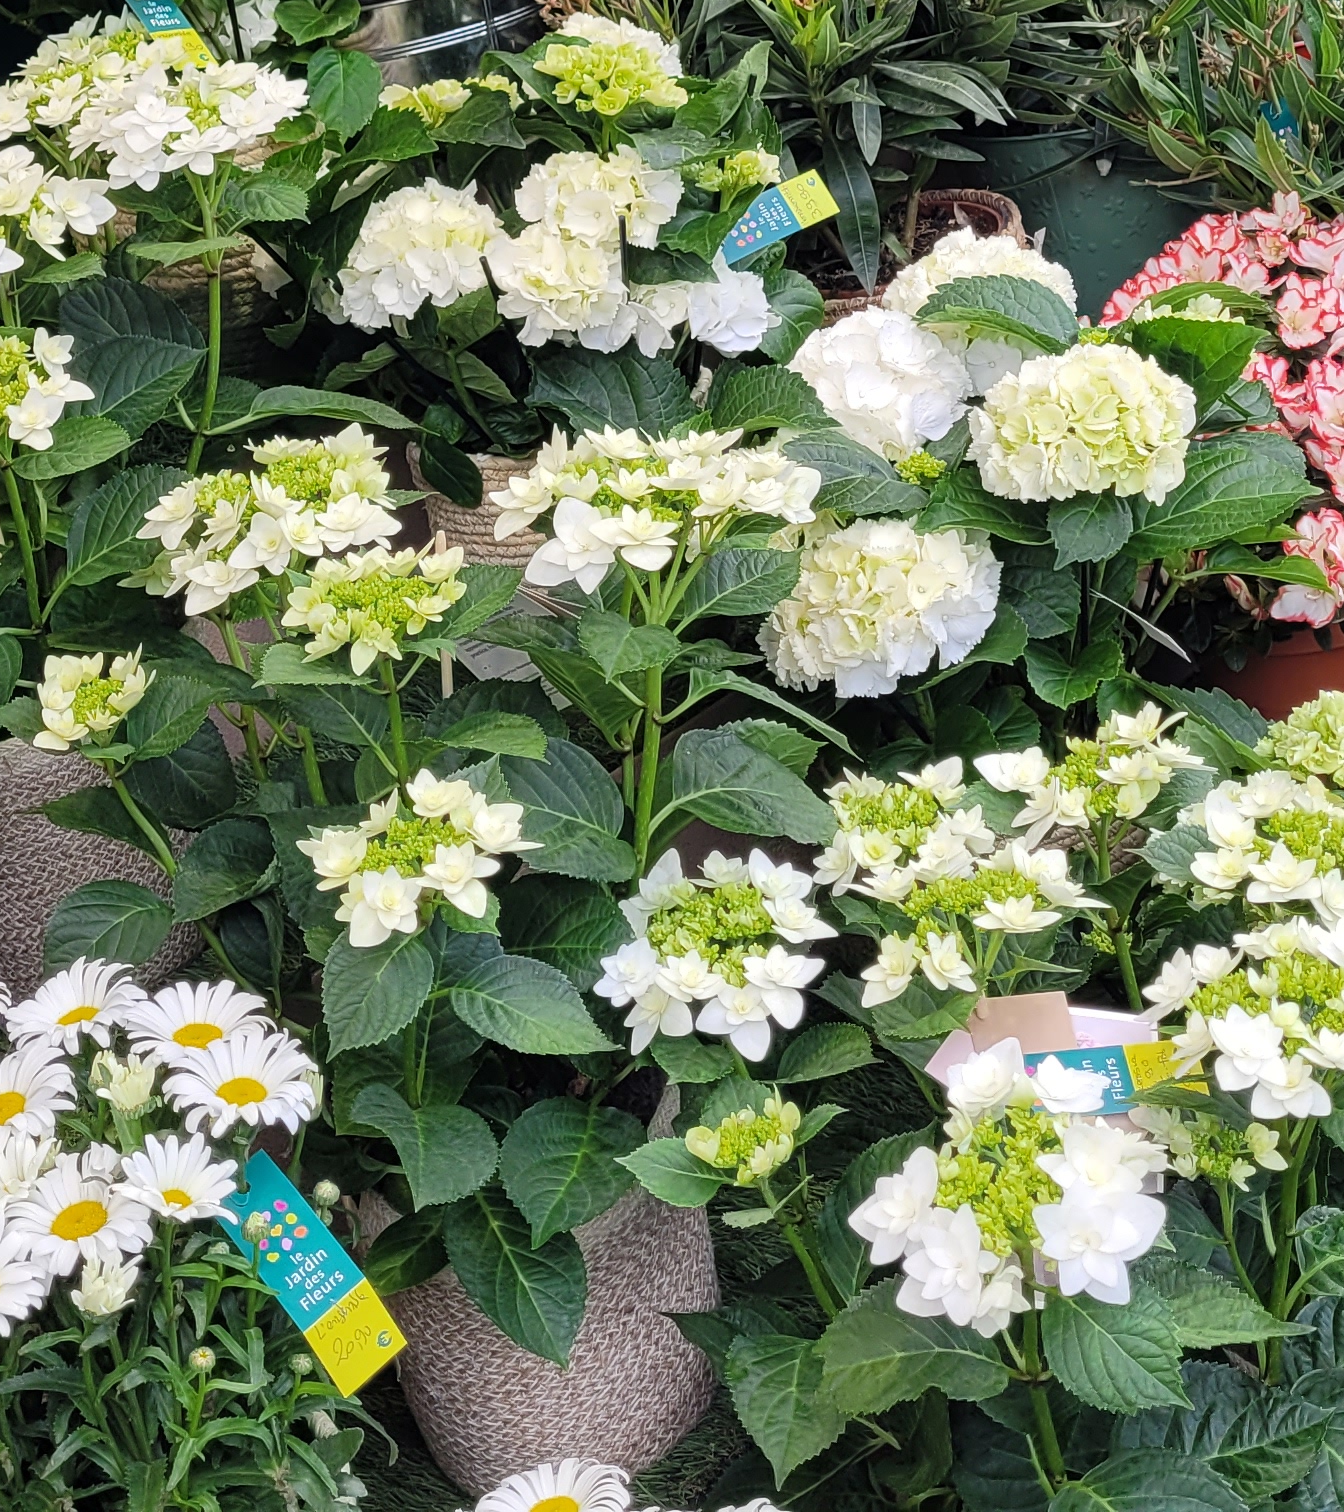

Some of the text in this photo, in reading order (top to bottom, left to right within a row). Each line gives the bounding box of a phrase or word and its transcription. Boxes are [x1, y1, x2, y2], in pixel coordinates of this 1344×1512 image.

[142, 5, 173, 15] Jardin
[149, 18, 181, 27] Fleurs
[758, 202, 779, 232] Jardin
[769, 207, 780, 221] des
[771, 196, 793, 227] Fleurs
[1106, 1057, 1125, 1101] Fleurs
[284, 1248, 329, 1290] Jardin
[289, 1251, 305, 1265] le
[299, 1269, 345, 1311] Fleurs
[304, 1269, 325, 1290] des
